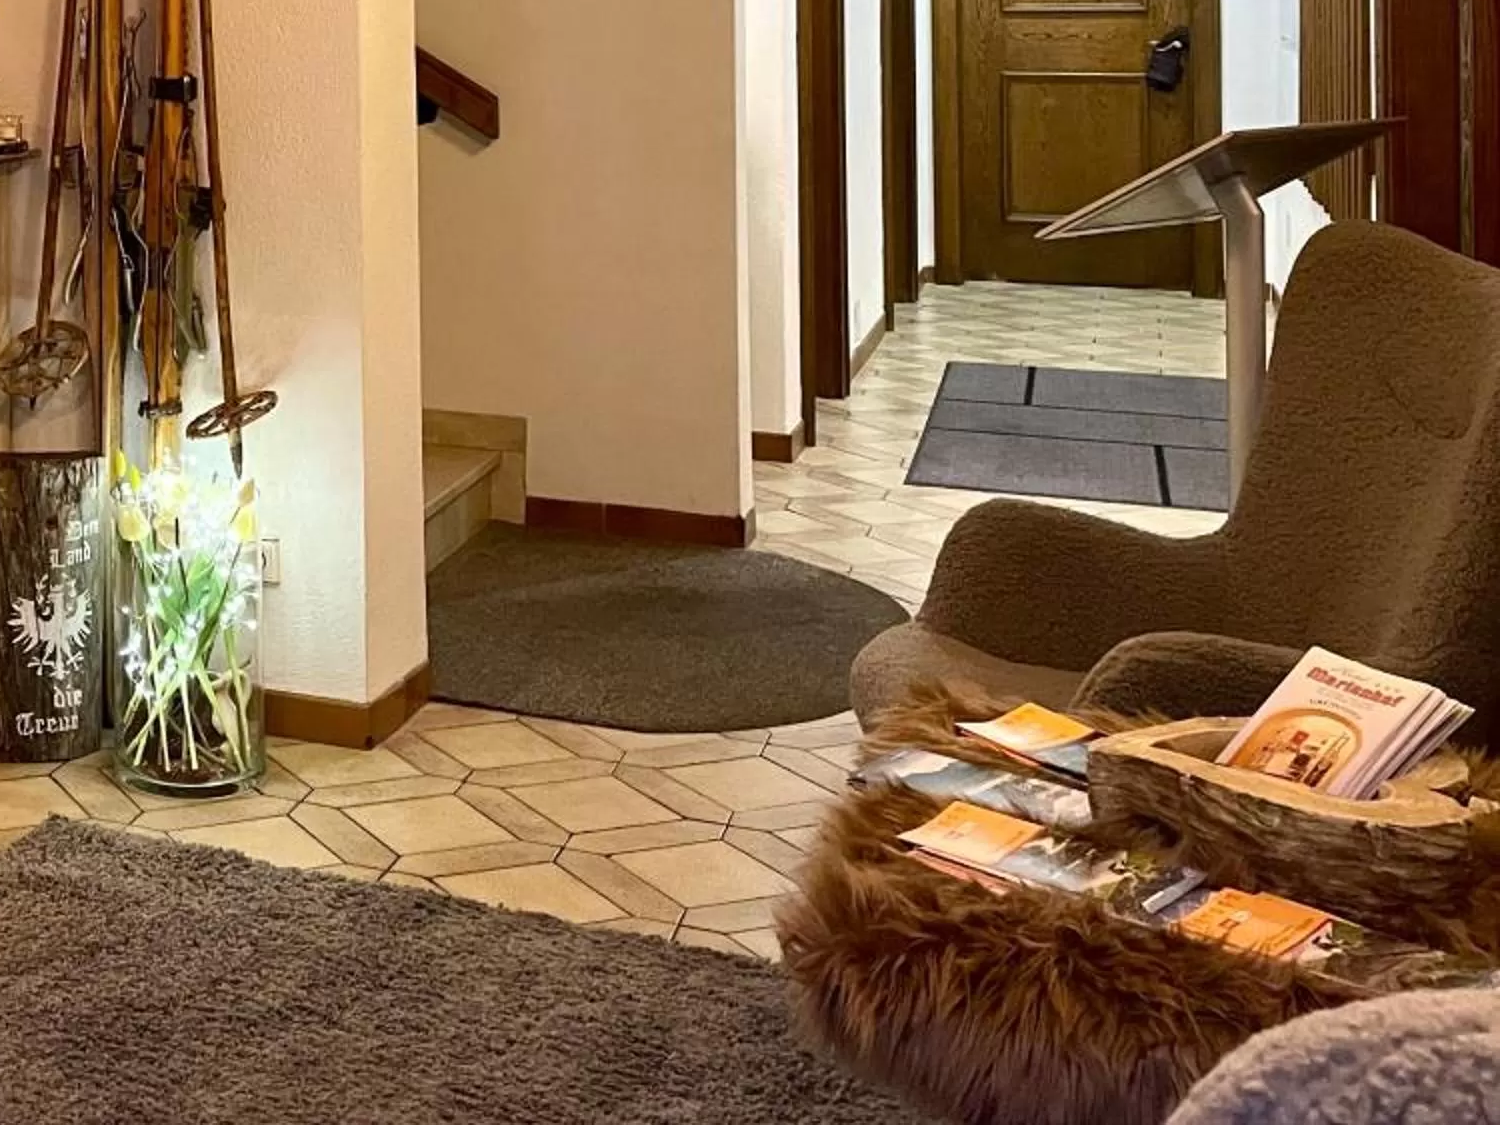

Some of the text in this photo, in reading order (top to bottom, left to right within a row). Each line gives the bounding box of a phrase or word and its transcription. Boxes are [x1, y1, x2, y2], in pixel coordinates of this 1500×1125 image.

[49, 540, 92, 569] Land
[53, 684, 83, 708] die
[15, 711, 80, 739] Treue
